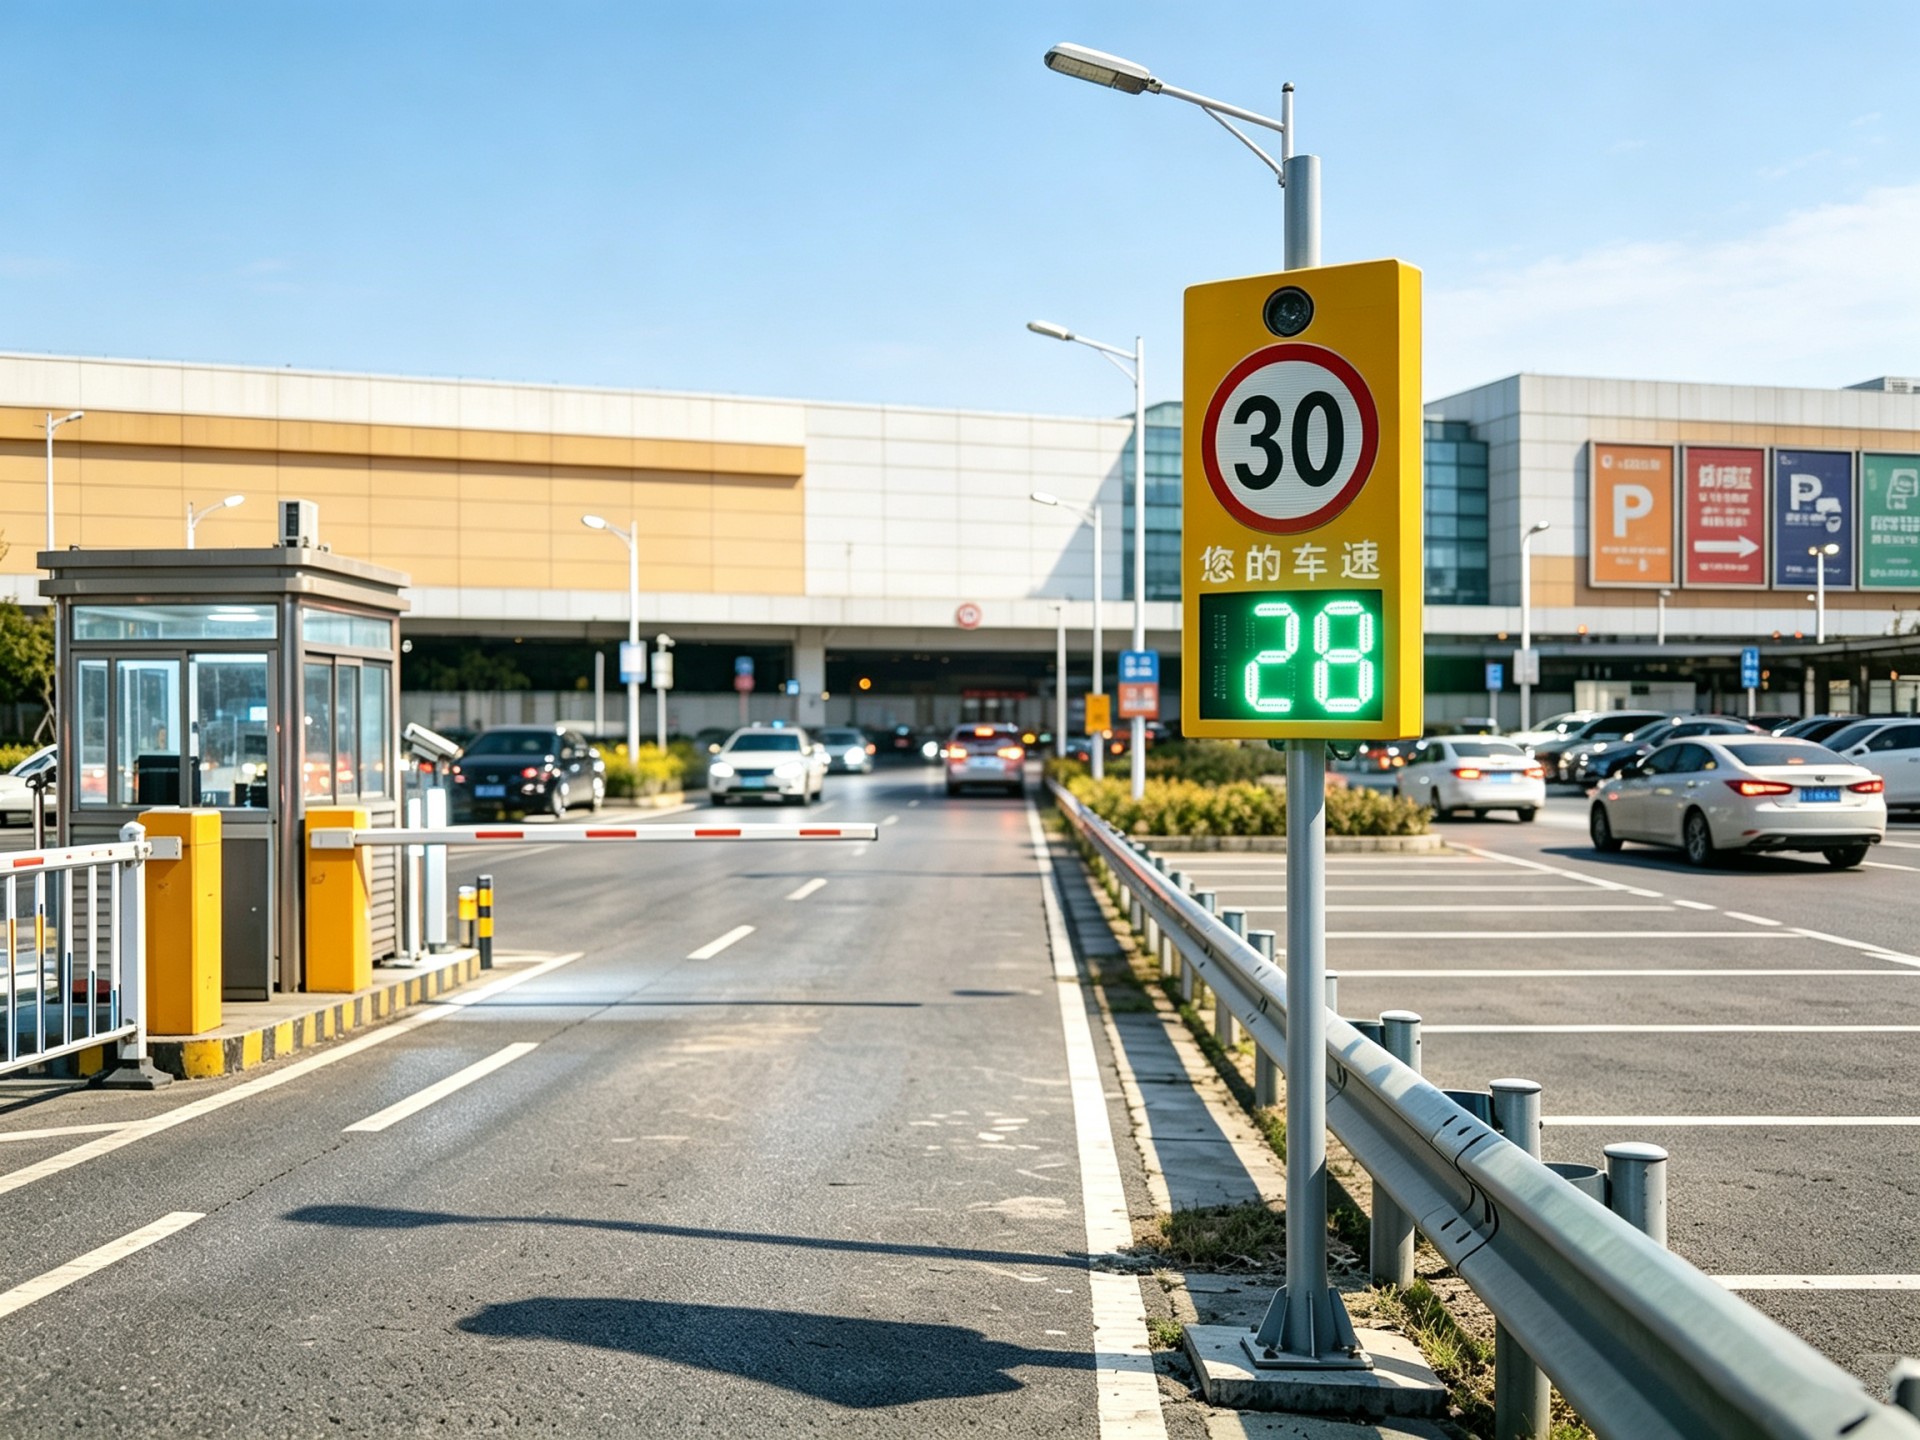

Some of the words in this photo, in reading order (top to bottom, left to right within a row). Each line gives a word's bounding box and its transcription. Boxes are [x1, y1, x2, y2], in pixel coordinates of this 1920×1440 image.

[1233, 390, 1345, 490] 30
[1613, 484, 1654, 538] P
[1790, 473, 1823, 511] P
[1199, 539, 1381, 584] 您的车速
[1244, 601, 1374, 713] 28
